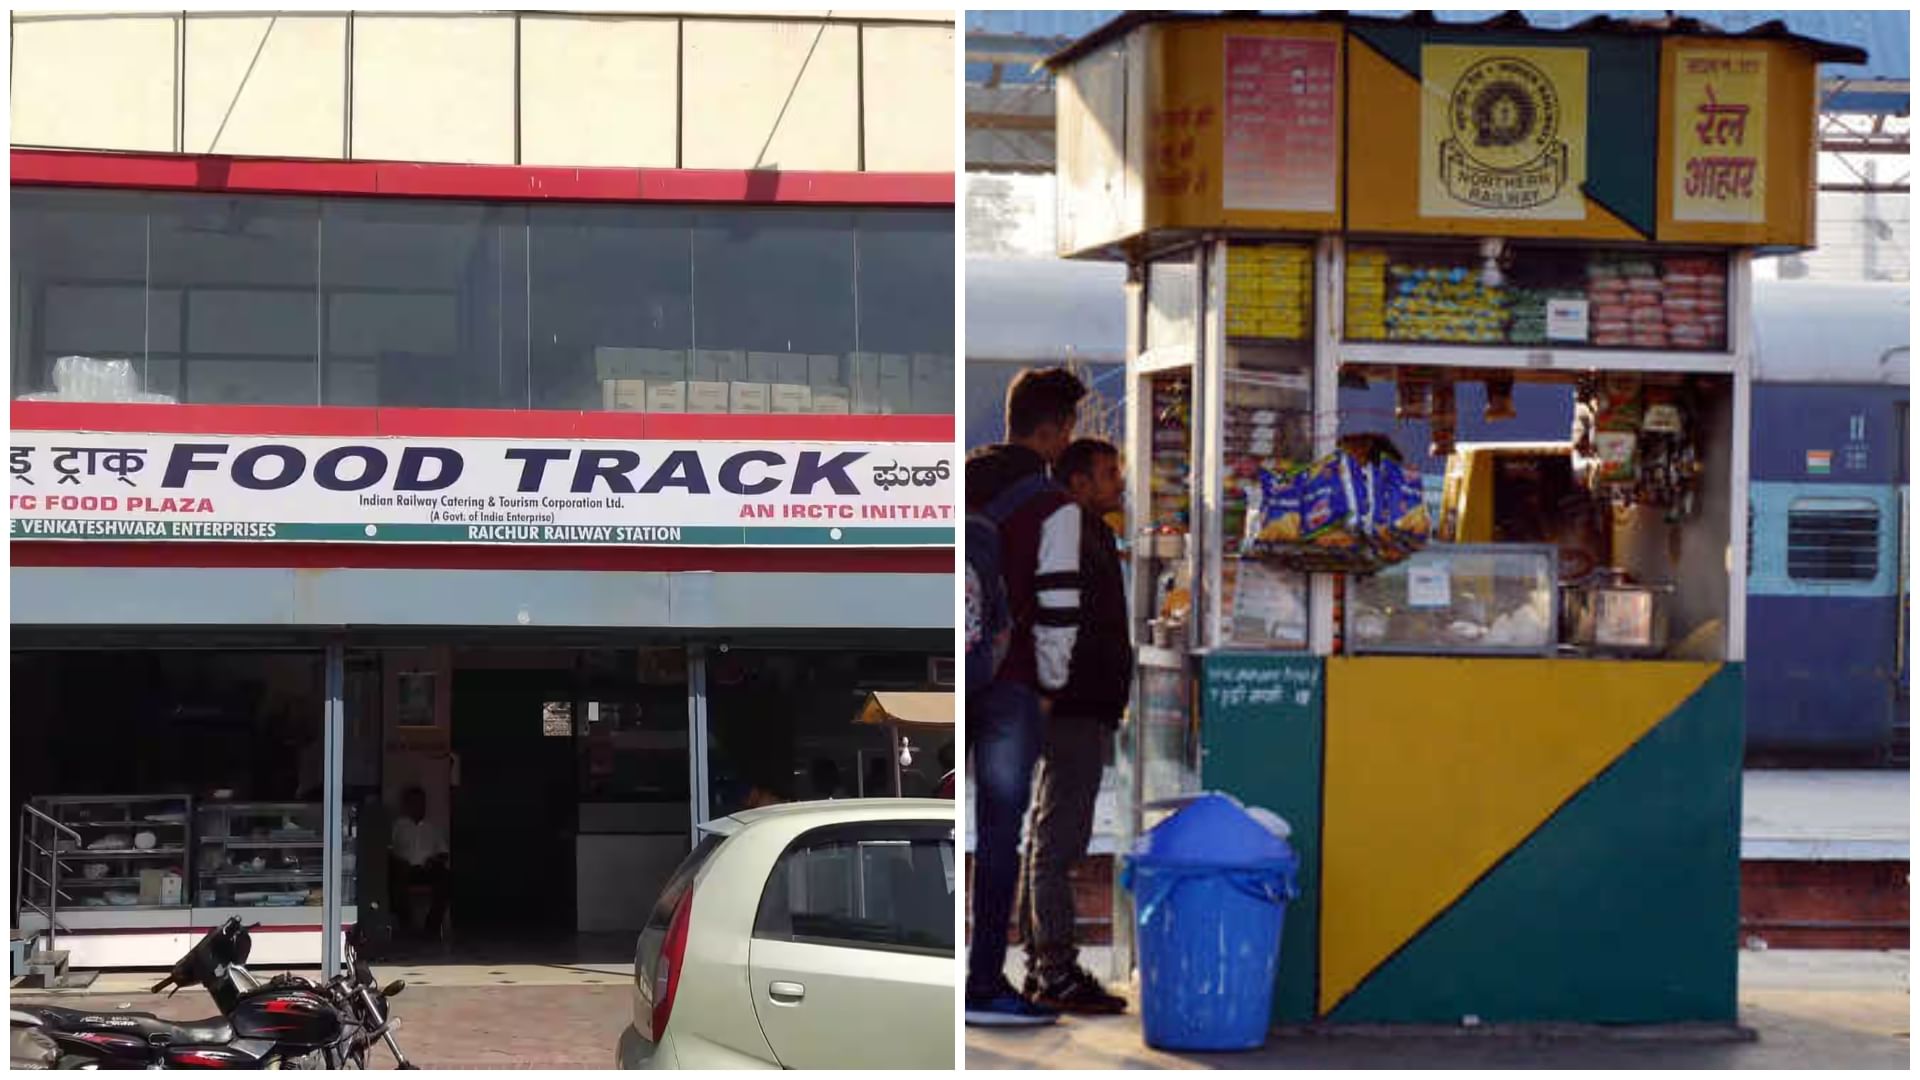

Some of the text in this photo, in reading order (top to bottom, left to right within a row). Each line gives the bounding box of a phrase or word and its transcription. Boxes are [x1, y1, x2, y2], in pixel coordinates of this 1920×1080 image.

[1695, 84, 1750, 146] रेल
[1457, 170, 1549, 190] NORTHERN
[1683, 155, 1758, 200] आहार
[50, 447, 148, 487] ट्राक्
[161, 443, 870, 495] FOOD TRACK
[45, 495, 118, 511] FOOD
[126, 497, 214, 513] PLAZA
[359, 494, 625, 511] Indian Railway Catering & Tourism Corporation Ltd.
[739, 504, 955, 519] AN IRCTC INITIAT
[442, 511, 466, 522] Govt.
[468, 511, 478, 522] of
[480, 512, 504, 522] India
[506, 512, 555, 524] Enterprise)
[21, 519, 167, 536] VENKATESHWARA
[172, 523, 276, 538] ENTERPRISES
[468, 526, 682, 541] RAICHUR RAILWAY STATION
